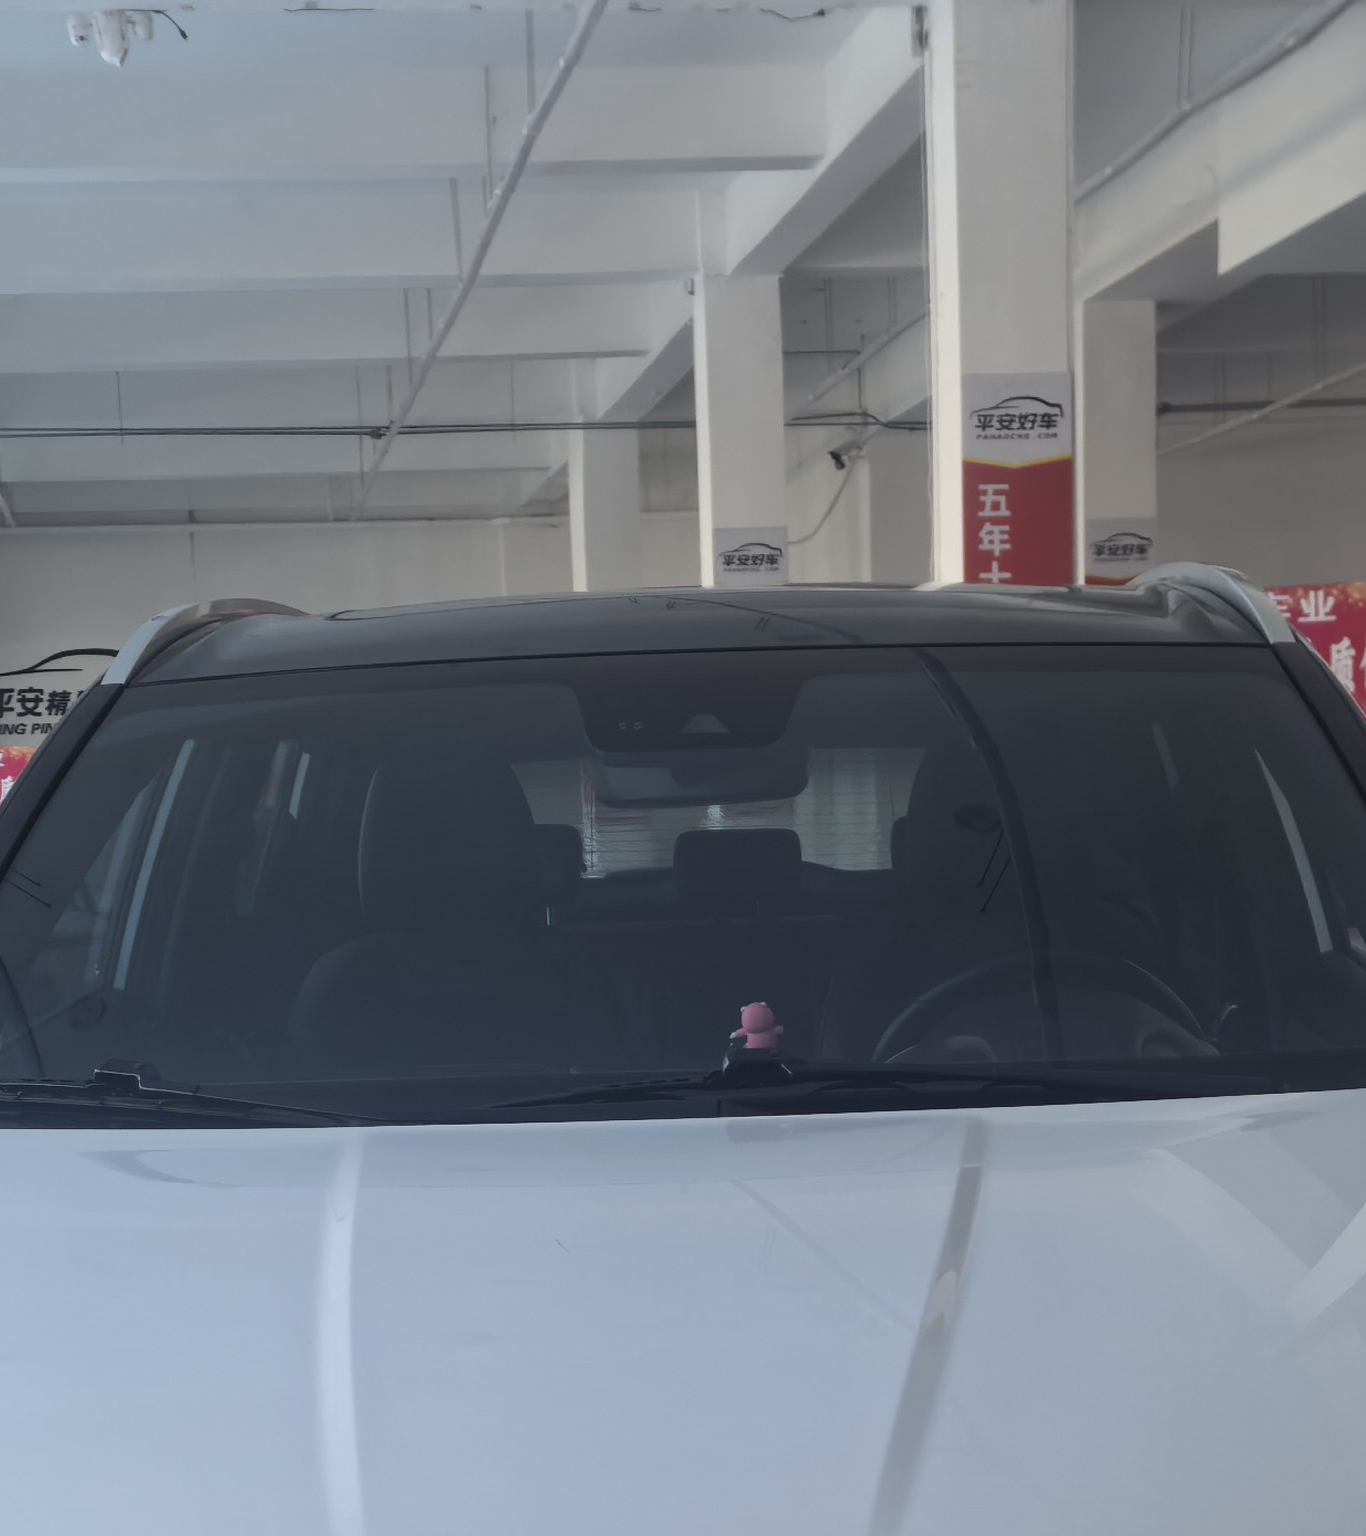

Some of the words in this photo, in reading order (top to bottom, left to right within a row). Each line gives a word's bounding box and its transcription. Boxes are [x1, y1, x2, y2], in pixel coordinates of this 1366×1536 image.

[975, 413, 1059, 431] 平安好车
[978, 484, 1013, 584] 五年十
